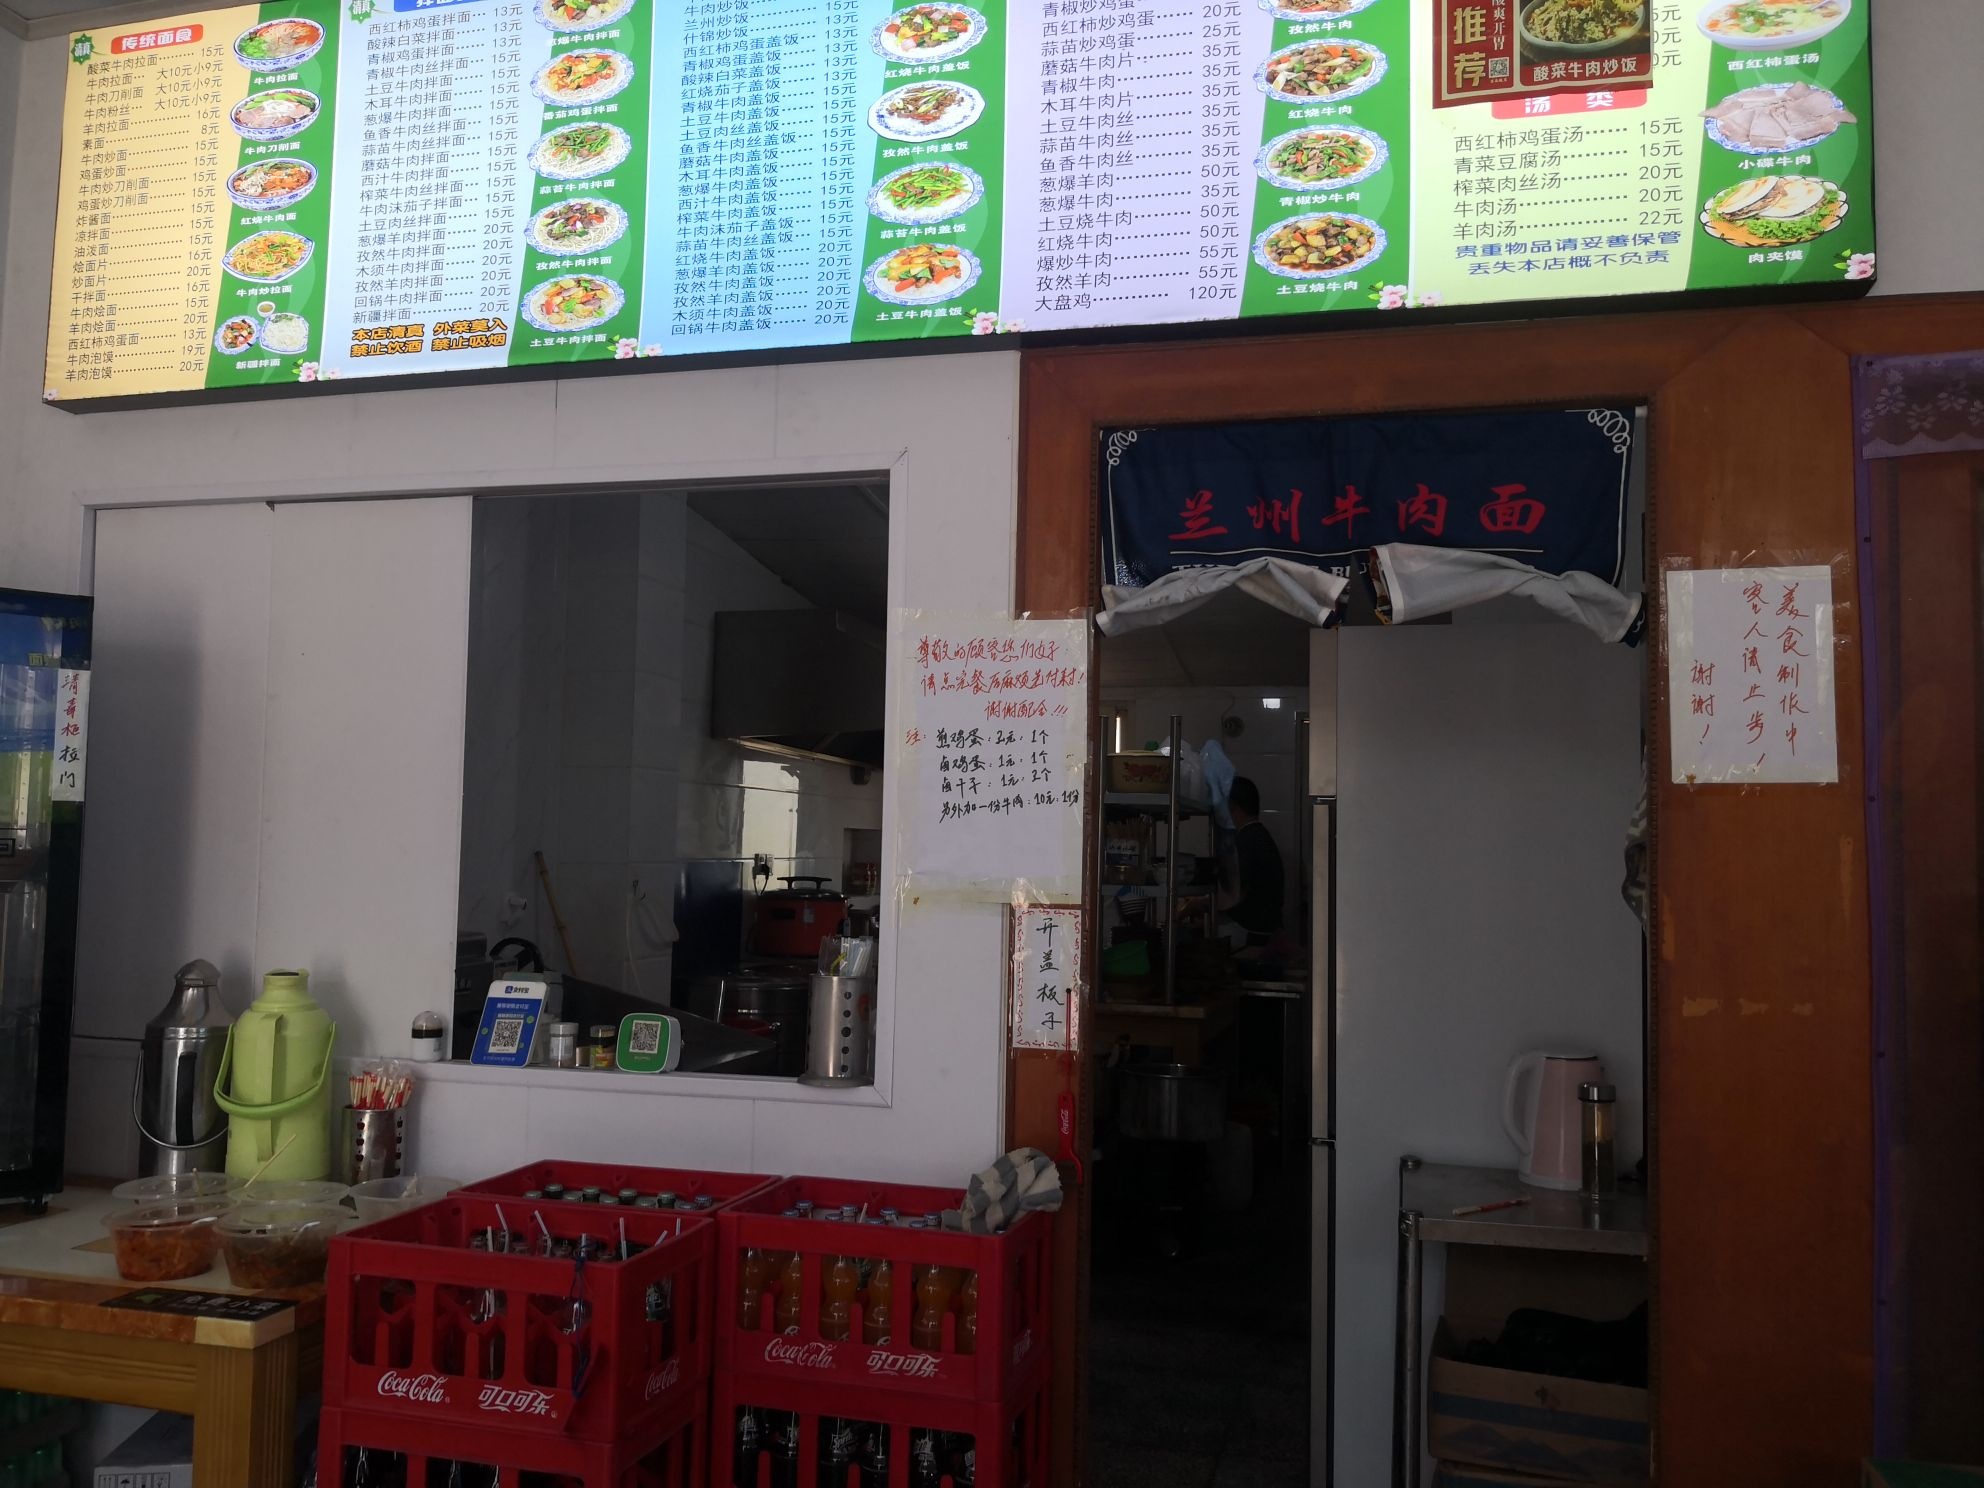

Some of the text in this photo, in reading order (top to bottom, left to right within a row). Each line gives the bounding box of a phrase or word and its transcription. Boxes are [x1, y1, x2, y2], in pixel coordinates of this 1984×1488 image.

[368, 4, 523, 36] 西红柿鸡蛋拌面 13元
[683, 1, 859, 31] 兰州炒饭 15元
[1043, 2, 1241, 37] 西红柿炒鸡蛋 20元
[1288, 19, 1352, 35] 孜然牛肉
[122, 28, 192, 50] 传统面食
[367, 36, 522, 66] 青椒鸡蛋拌面 13元
[683, 28, 857, 58] 西红柿鸡蛋盖饭 13元
[1454, 6, 1487, 88] 推荐
[87, 46, 224, 76] 酸菜牛肉拉面 15元
[681, 56, 857, 86] 酸辣白菜盖饭 13元
[884, 61, 970, 79] 红烧牛肉盖饭
[1041, 42, 1240, 77] 蘑菇牛肉片 35元
[1533, 57, 1637, 82] 酸菜牛肉炒饭
[1728, 53, 1819, 70] 西红柿蛋汤
[86, 74, 133, 88] 牛肉拉面
[254, 73, 298, 85] 牛肉拉面
[365, 66, 520, 96] 土豆牛肉拌面 15元
[85, 87, 144, 105] 牛肉刀削面
[681, 84, 856, 113] 青椒牛肉盖饭 15元
[1041, 82, 1240, 114] 木耳牛肉片 35元
[83, 108, 220, 135] 羊肉拉面 16元
[84, 104, 131, 120] 牛肉粉丝
[363, 97, 519, 127] 葱爆牛肉拌面 15元
[543, 104, 618, 120] 番茄鸡蛋拌面
[1288, 106, 1352, 119] 红烧牛肉
[82, 124, 219, 150] 素面 8元
[680, 113, 856, 141] 土豆肉丝盖饭 15元
[1040, 122, 1240, 154] 蒜苗牛肉丝 35元
[1454, 117, 1683, 154] 西红柿鸡蛋汤 15元
[245, 142, 300, 155] 牛肉刀削面
[362, 128, 518, 157] 蒜苗牛肉丝拌面 15元
[882, 140, 968, 159] 孜然牛肉盖饭
[80, 155, 218, 180] 鸡蛋炒面 15元
[679, 156, 854, 183] 木耳牛肉盖饭 15元
[1454, 140, 1683, 175] 青菜豆腐汤 15元
[1738, 154, 1811, 171] 小碟牛肉
[361, 159, 517, 188] 西汁牛肉拌面 15元
[1039, 162, 1239, 193] 葱爆羊肉 50元
[1453, 162, 1683, 196] 榨菜肉丝汤 20元
[78, 188, 216, 211] 鸡蛋炒刀削面 15元
[359, 191, 515, 217] 牛肉沫茄子拌面 15元
[678, 184, 854, 211] 西汁牛肉盖饭 15元
[1279, 192, 1360, 206] 青椒炒牛肉
[1454, 185, 1683, 219] 牛肉汤 20元
[241, 213, 296, 225] 红烧牛肉面
[677, 213, 853, 238] 牛肉沫茄子盖饭 15元
[1039, 202, 1239, 232] 土豆烧牛肉 50元
[1453, 207, 1683, 241] 羊肉汤 22元
[75, 219, 214, 243] 凉拌面 15元
[357, 222, 514, 248] 葱爆羊肉拌面 20元
[676, 242, 852, 266] 红烧牛肉盖饭 20元
[1037, 244, 1238, 271] 爆炒牛肉 55元
[1454, 230, 1681, 259] 贵重物品请妥善保管
[73, 250, 212, 273] 烩面片 16元
[355, 254, 512, 278] 木须牛肉拌面 20元
[536, 256, 612, 271] 孜然牛肉拌面
[1468, 249, 1669, 276] 丢失本店概不负责
[236, 285, 292, 297] 牛肉炒拉面
[1036, 264, 1238, 292] 孜然羊肉 55元
[1276, 281, 1358, 295] 土豆烧牛肉
[71, 281, 210, 304] 干拌面 16元
[355, 285, 511, 308] 回锅牛肉拌面 20元
[1035, 285, 1237, 312] 大盘鸡 120元
[69, 313, 208, 335] 羊肉烩面 20元
[671, 314, 849, 336] 回锅牛肉盖饭 20元
[875, 306, 962, 322] 土豆牛肉盖饭
[352, 318, 507, 341] 本店清真 外菜莫入
[530, 334, 607, 348] 土豆牛肉拌面
[67, 344, 205, 366] 牛肉泡馍 19元
[350, 334, 506, 358] 禁止饮酒 禁止吸烟
[1168, 483, 1547, 541] 兰州牛肉面
[764, 1338, 943, 1377] Coca-Cola 可口可乐
[378, 1371, 554, 1415] Coca-Cola 可口可乐
